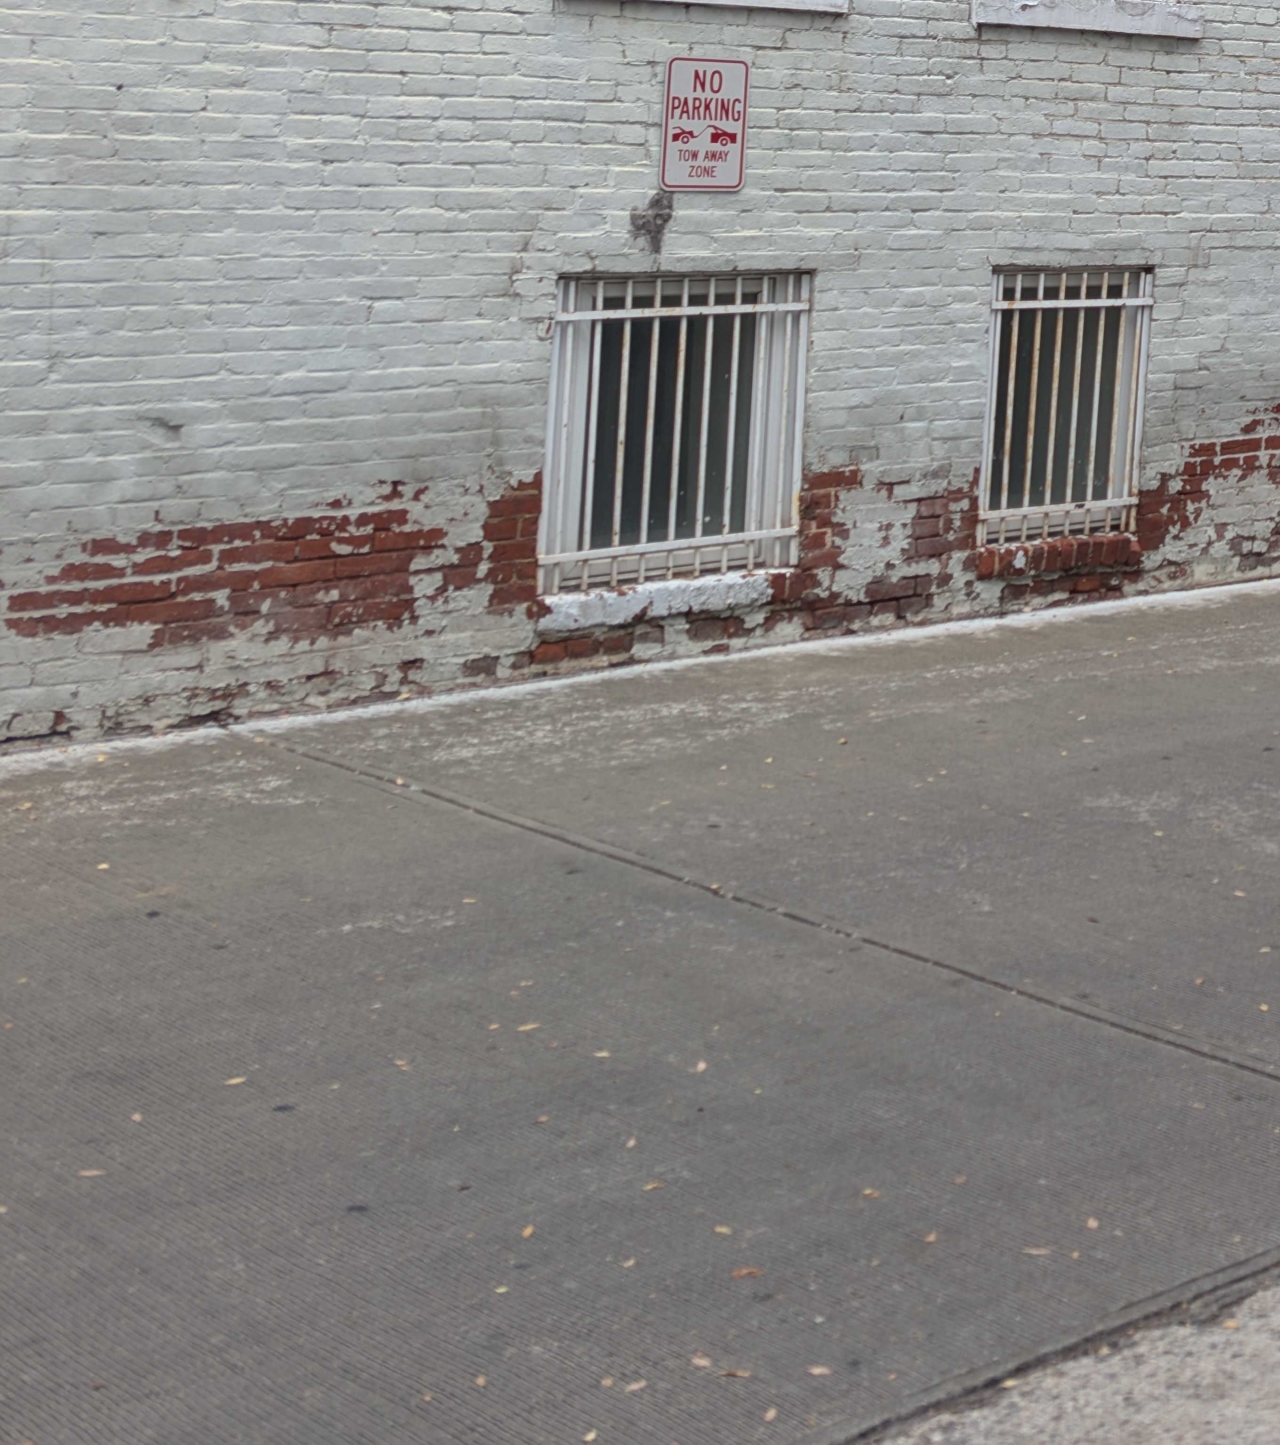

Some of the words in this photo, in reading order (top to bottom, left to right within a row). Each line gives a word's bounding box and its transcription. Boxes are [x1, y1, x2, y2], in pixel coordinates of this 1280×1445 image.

[692, 69, 723, 94] NO
[670, 96, 742, 122] PARKING
[677, 149, 699, 162] TOW
[702, 150, 730, 162] AWAY
[687, 165, 717, 178] ZONE
